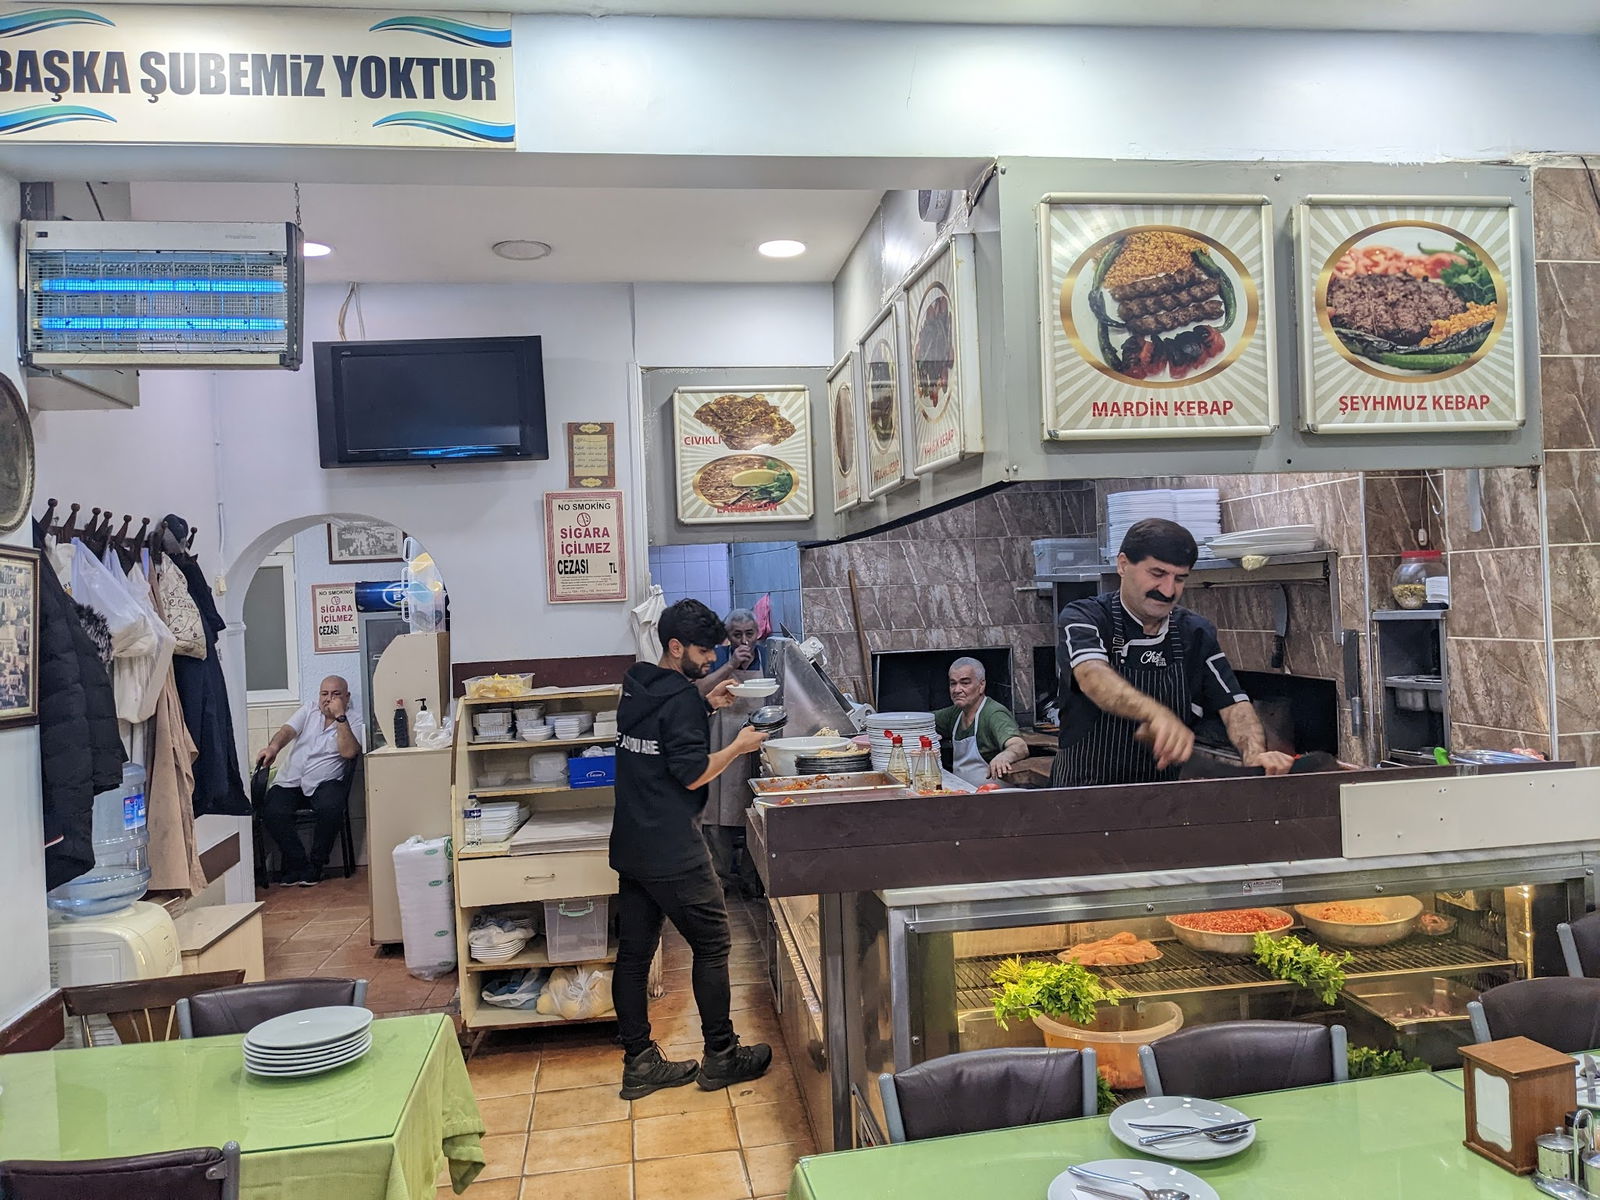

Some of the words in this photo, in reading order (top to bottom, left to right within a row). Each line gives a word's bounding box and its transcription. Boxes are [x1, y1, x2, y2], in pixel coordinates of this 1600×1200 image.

[0, 50, 131, 102] BAŞKA
[332, 55, 497, 101] YOKTUR
[1092, 398, 1168, 417] MARDİN
[1174, 401, 1234, 416] KEBAP
[1338, 395, 1427, 415] ŞEYHMUZ
[1432, 394, 1490, 410] KEBAP
[560, 526, 610, 539] SİGARA
[561, 541, 611, 557] İÇİLMEZ
[557, 559, 589, 574] CEZASI
[609, 562, 617, 574] TL
[320, 604, 353, 613] SİGARA
[321, 614, 353, 623] İÇİLMEZ
[319, 625, 339, 635] CEZASI
[352, 626, 358, 634] TL
